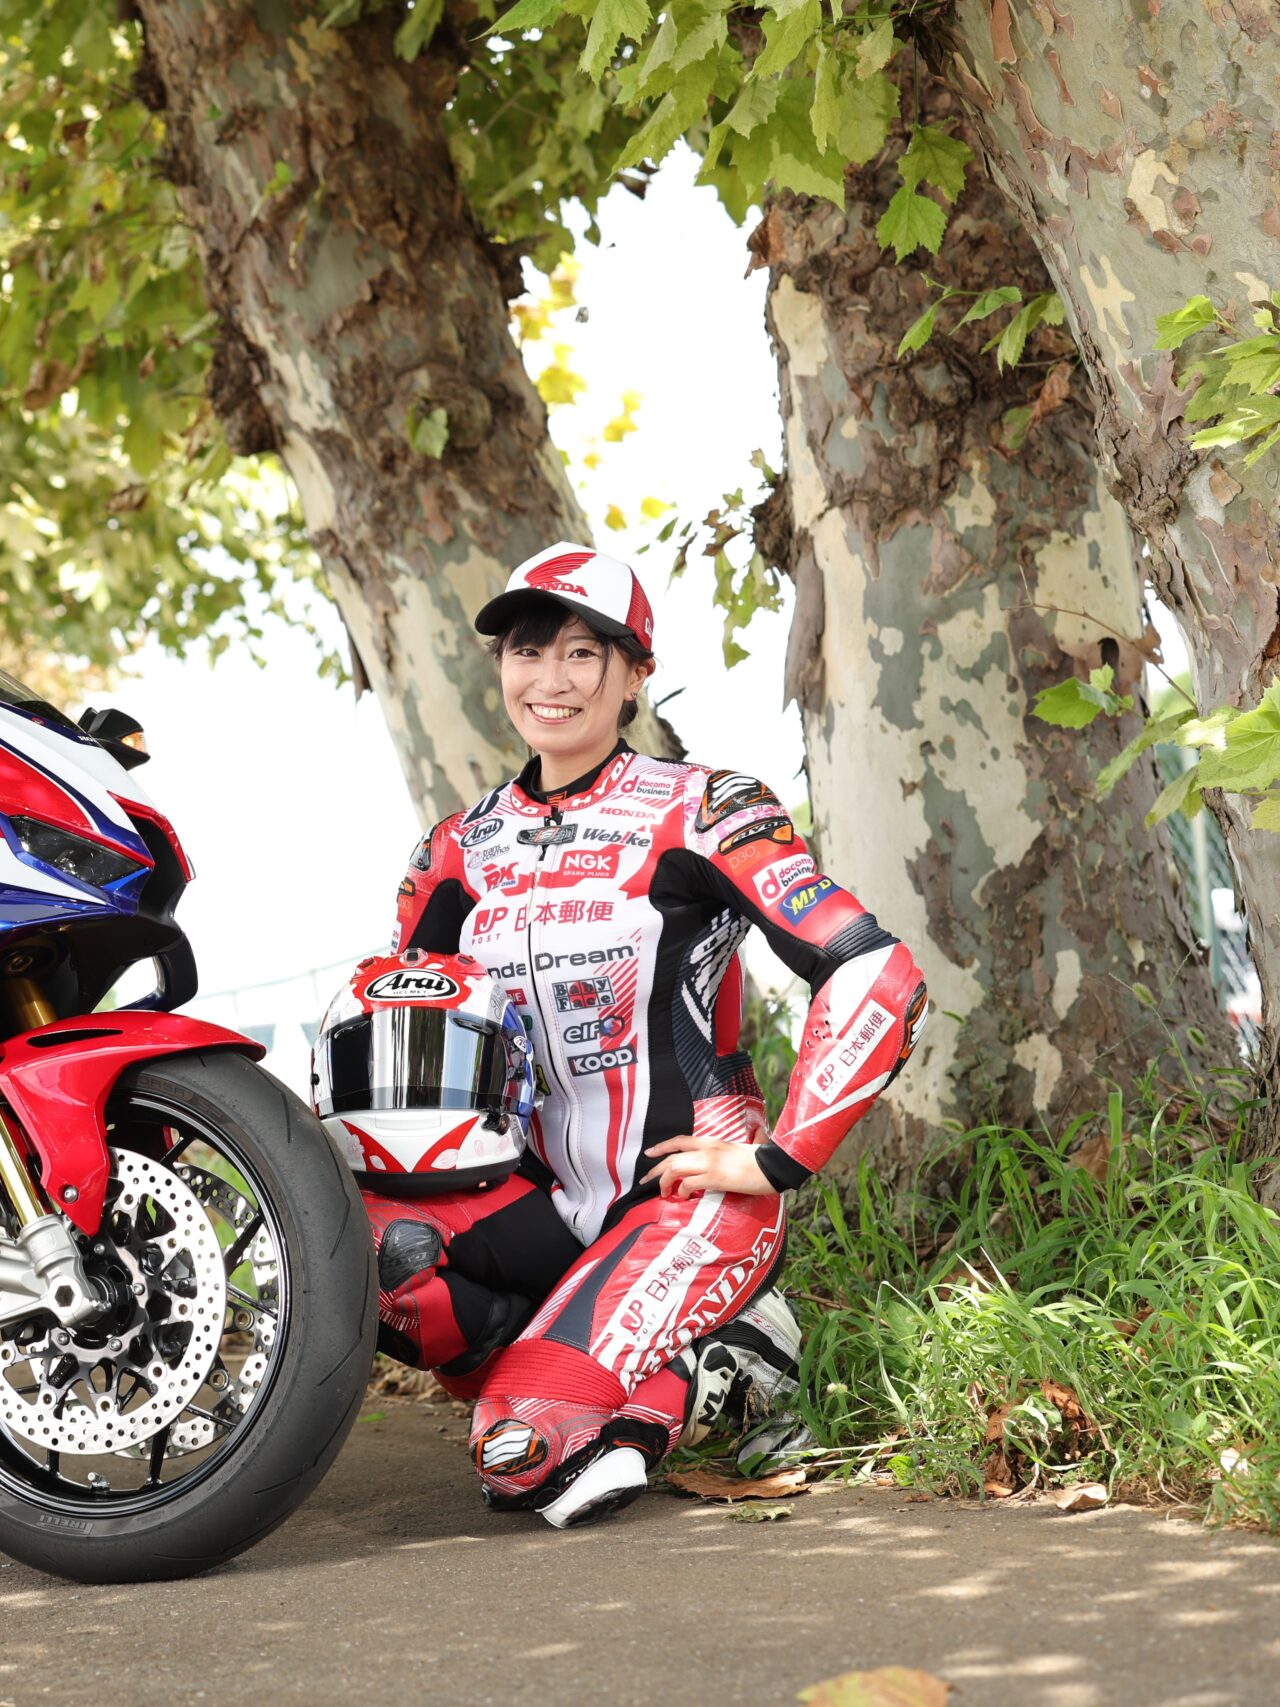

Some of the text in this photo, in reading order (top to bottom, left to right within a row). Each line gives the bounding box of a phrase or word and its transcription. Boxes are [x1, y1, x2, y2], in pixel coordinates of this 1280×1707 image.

[636, 787, 670, 796] business
[638, 779, 671, 789] docomo
[598, 807, 657, 820] HONDA
[466, 820, 498, 843] Arai
[564, 854, 613, 870] NGK
[514, 900, 615, 932] 日本郵便
[534, 945, 634, 972] Dream
[371, 973, 446, 996] Arai
[554, 979, 608, 997] Baby
[558, 994, 611, 1012] Face
[564, 1018, 603, 1044] elf
[839, 1010, 886, 1067] 日本郵便
[573, 1050, 634, 1074] KOOD
[645, 1238, 708, 1302] 日本郵便
[39, 1514, 94, 1536] PIRELLI
